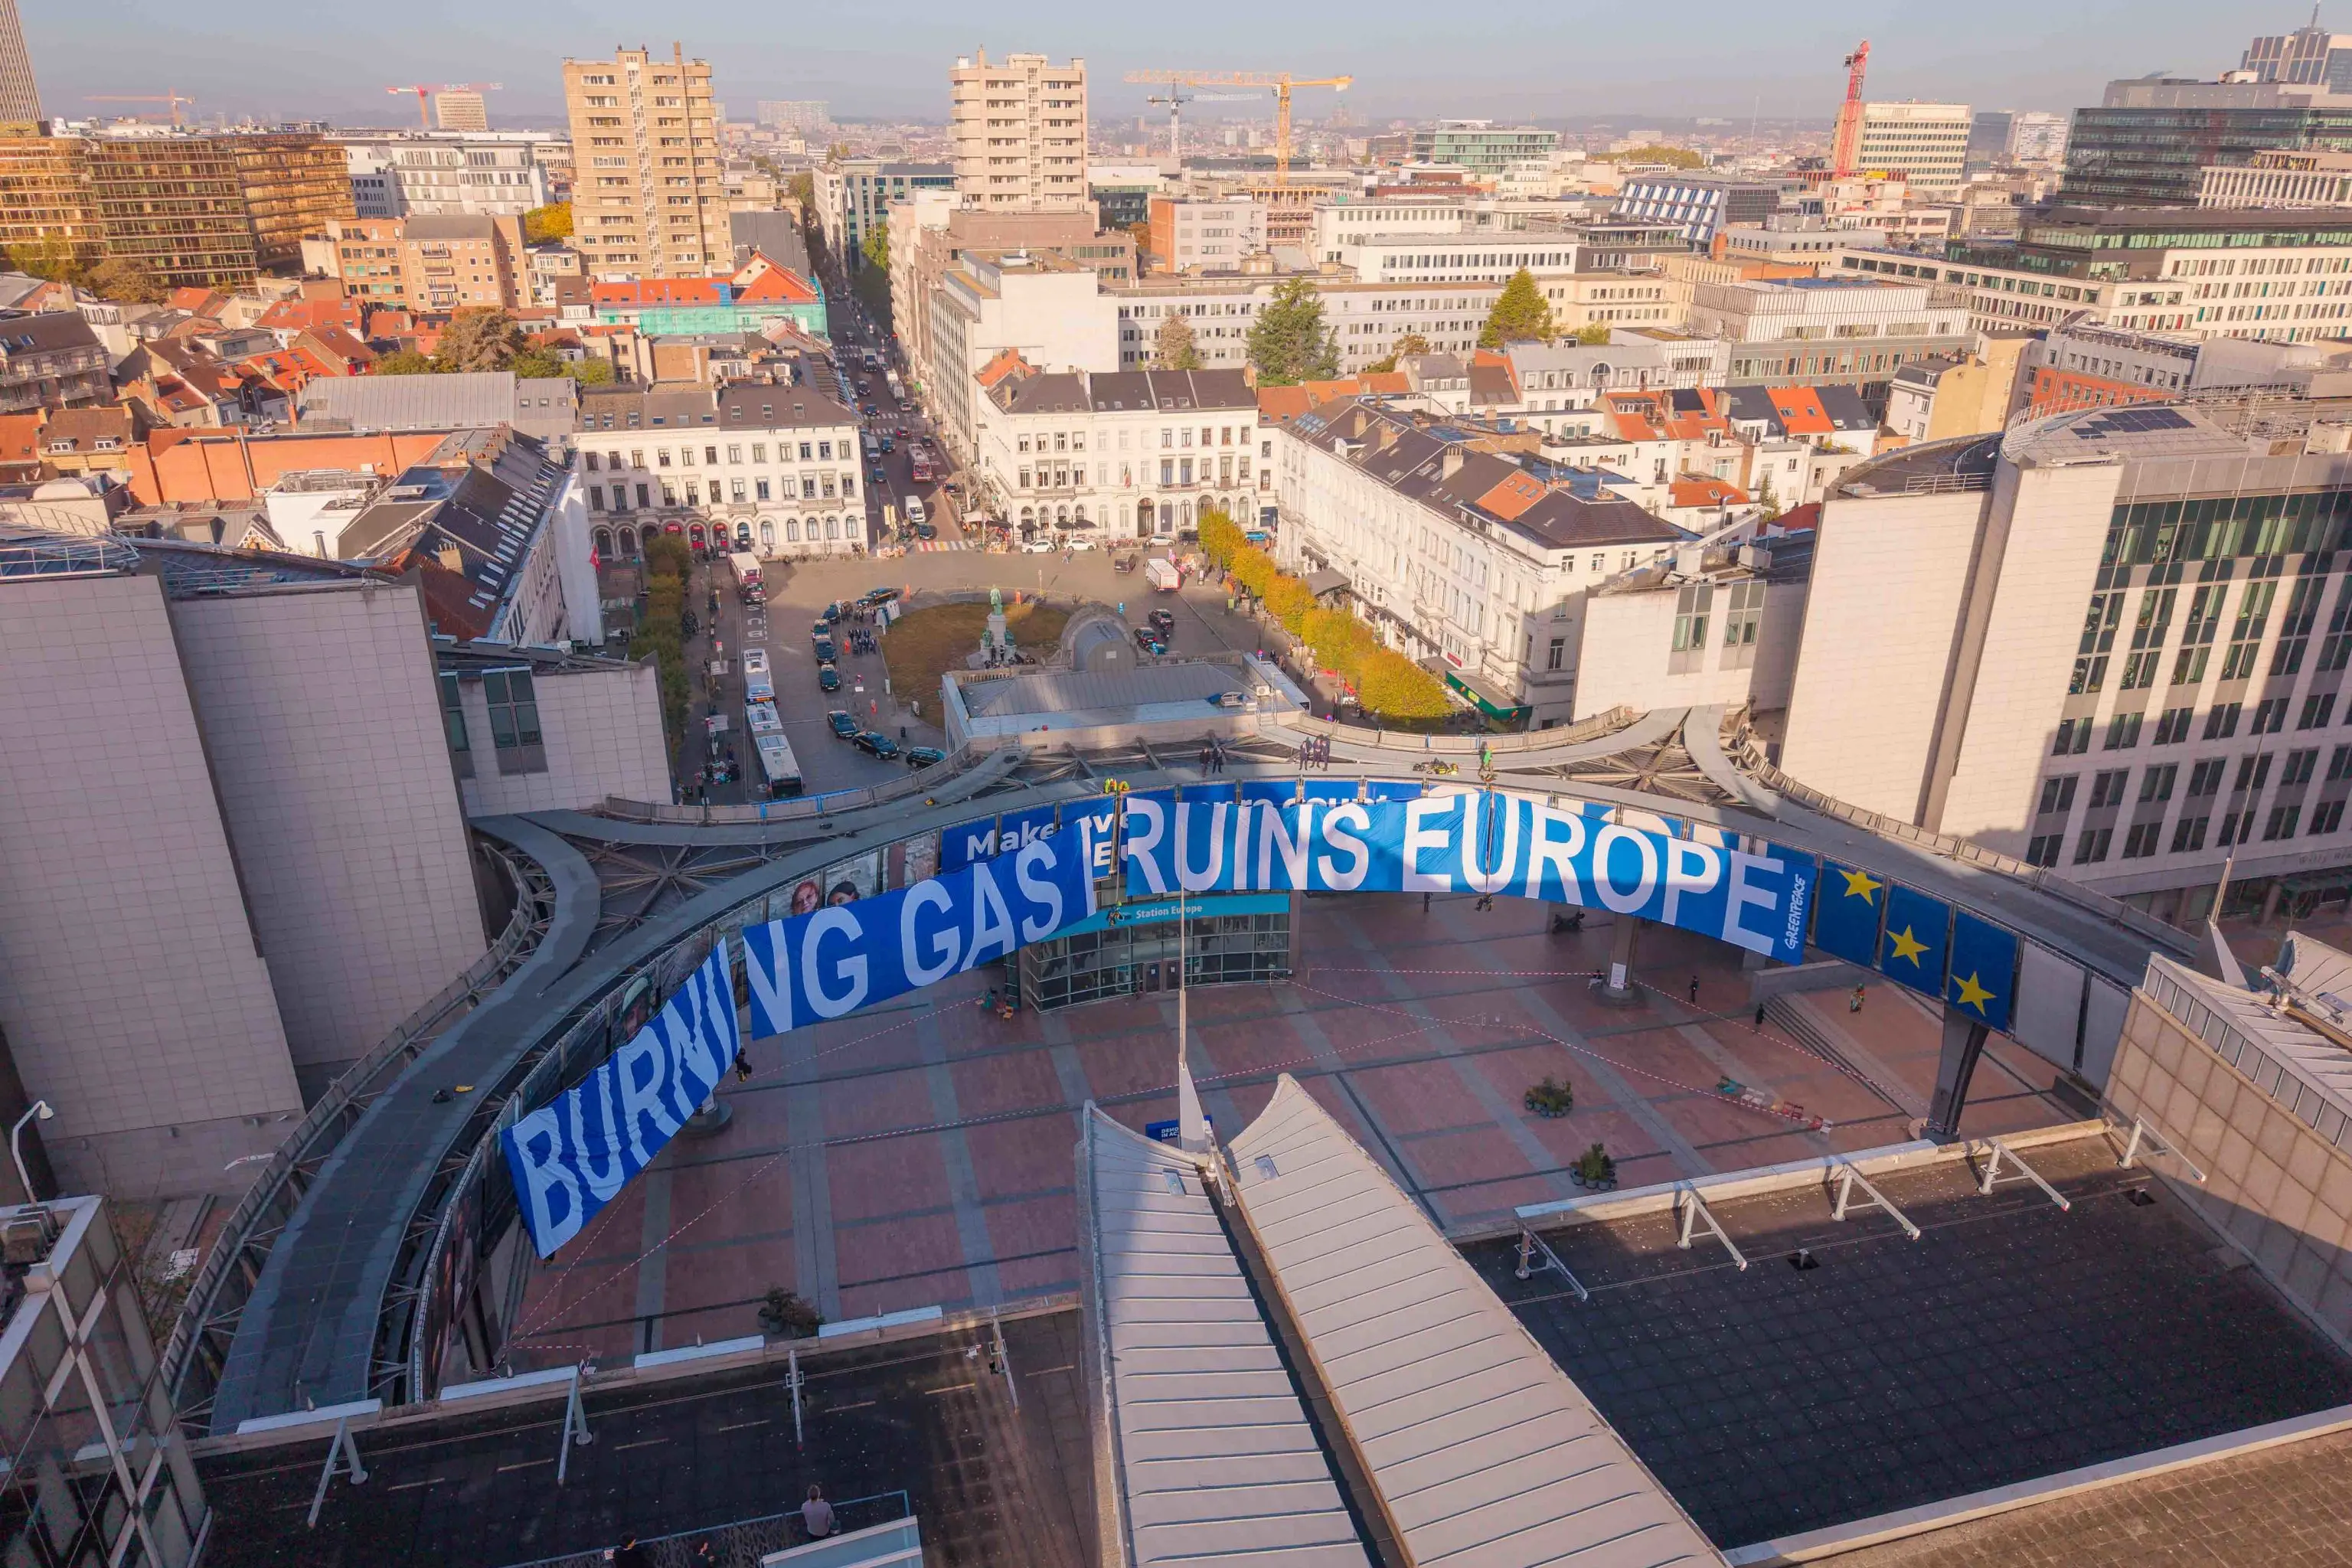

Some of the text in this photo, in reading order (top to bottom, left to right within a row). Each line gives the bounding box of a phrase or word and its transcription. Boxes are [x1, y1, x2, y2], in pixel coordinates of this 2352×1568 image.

[967, 821, 1063, 861] Make
[1135, 907, 1169, 919] Station
[1784, 874, 1806, 949] GREENPEACE
[511, 791, 1785, 1259] BURNING GAS RUINS EUROPE
